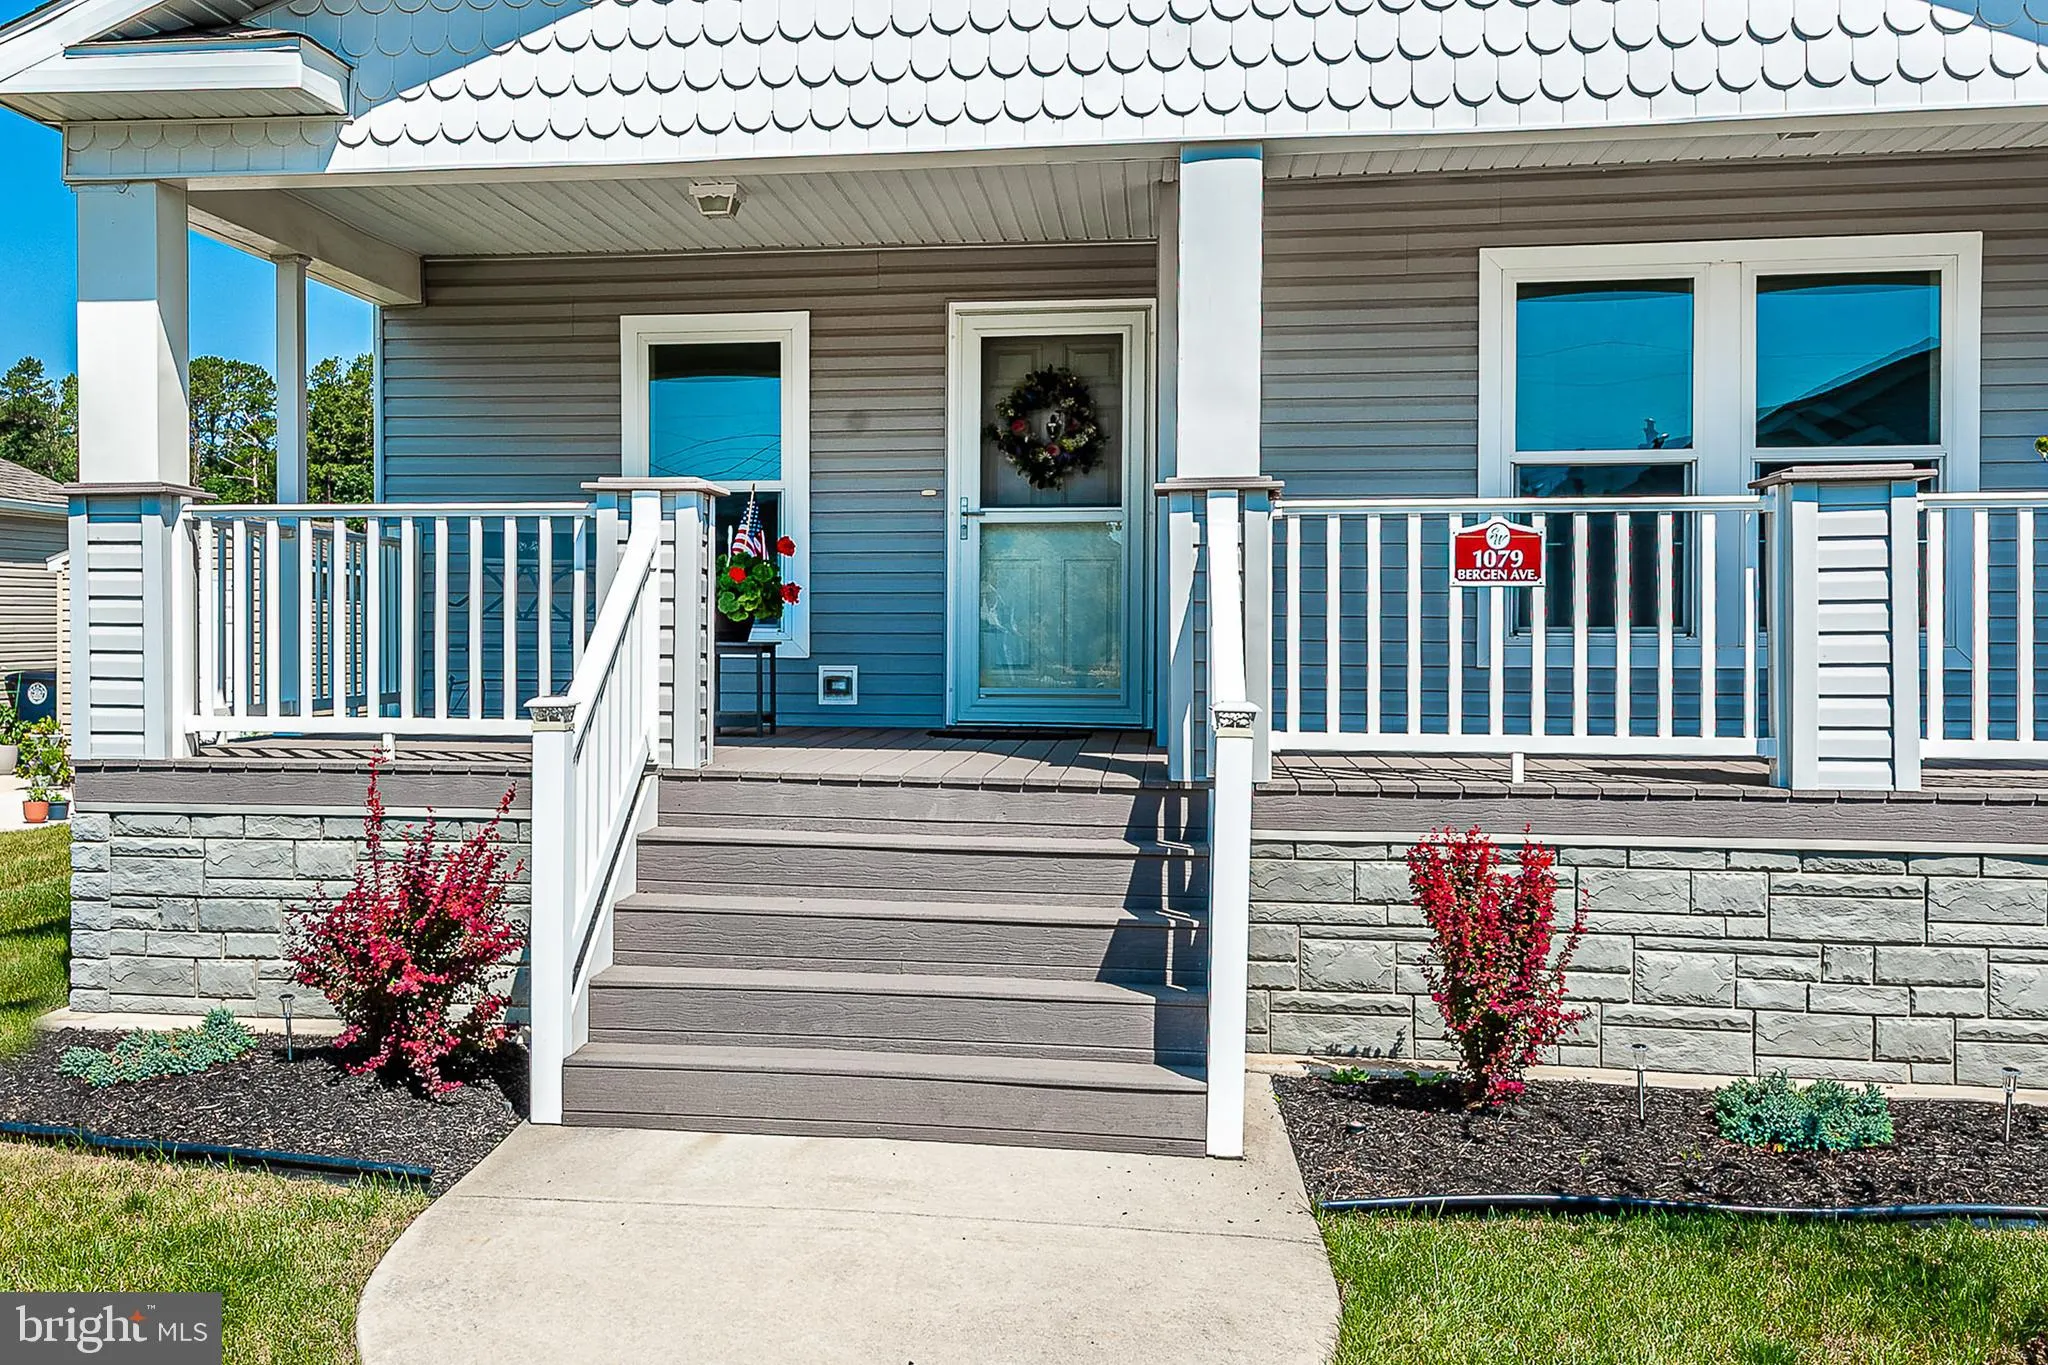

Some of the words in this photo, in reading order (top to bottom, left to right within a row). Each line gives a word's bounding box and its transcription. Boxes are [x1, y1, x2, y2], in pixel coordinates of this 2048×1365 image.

[1472, 549, 1524, 568] 1079
[1457, 569, 1508, 580] BERGEN
[1510, 569, 1538, 580] AVE.
